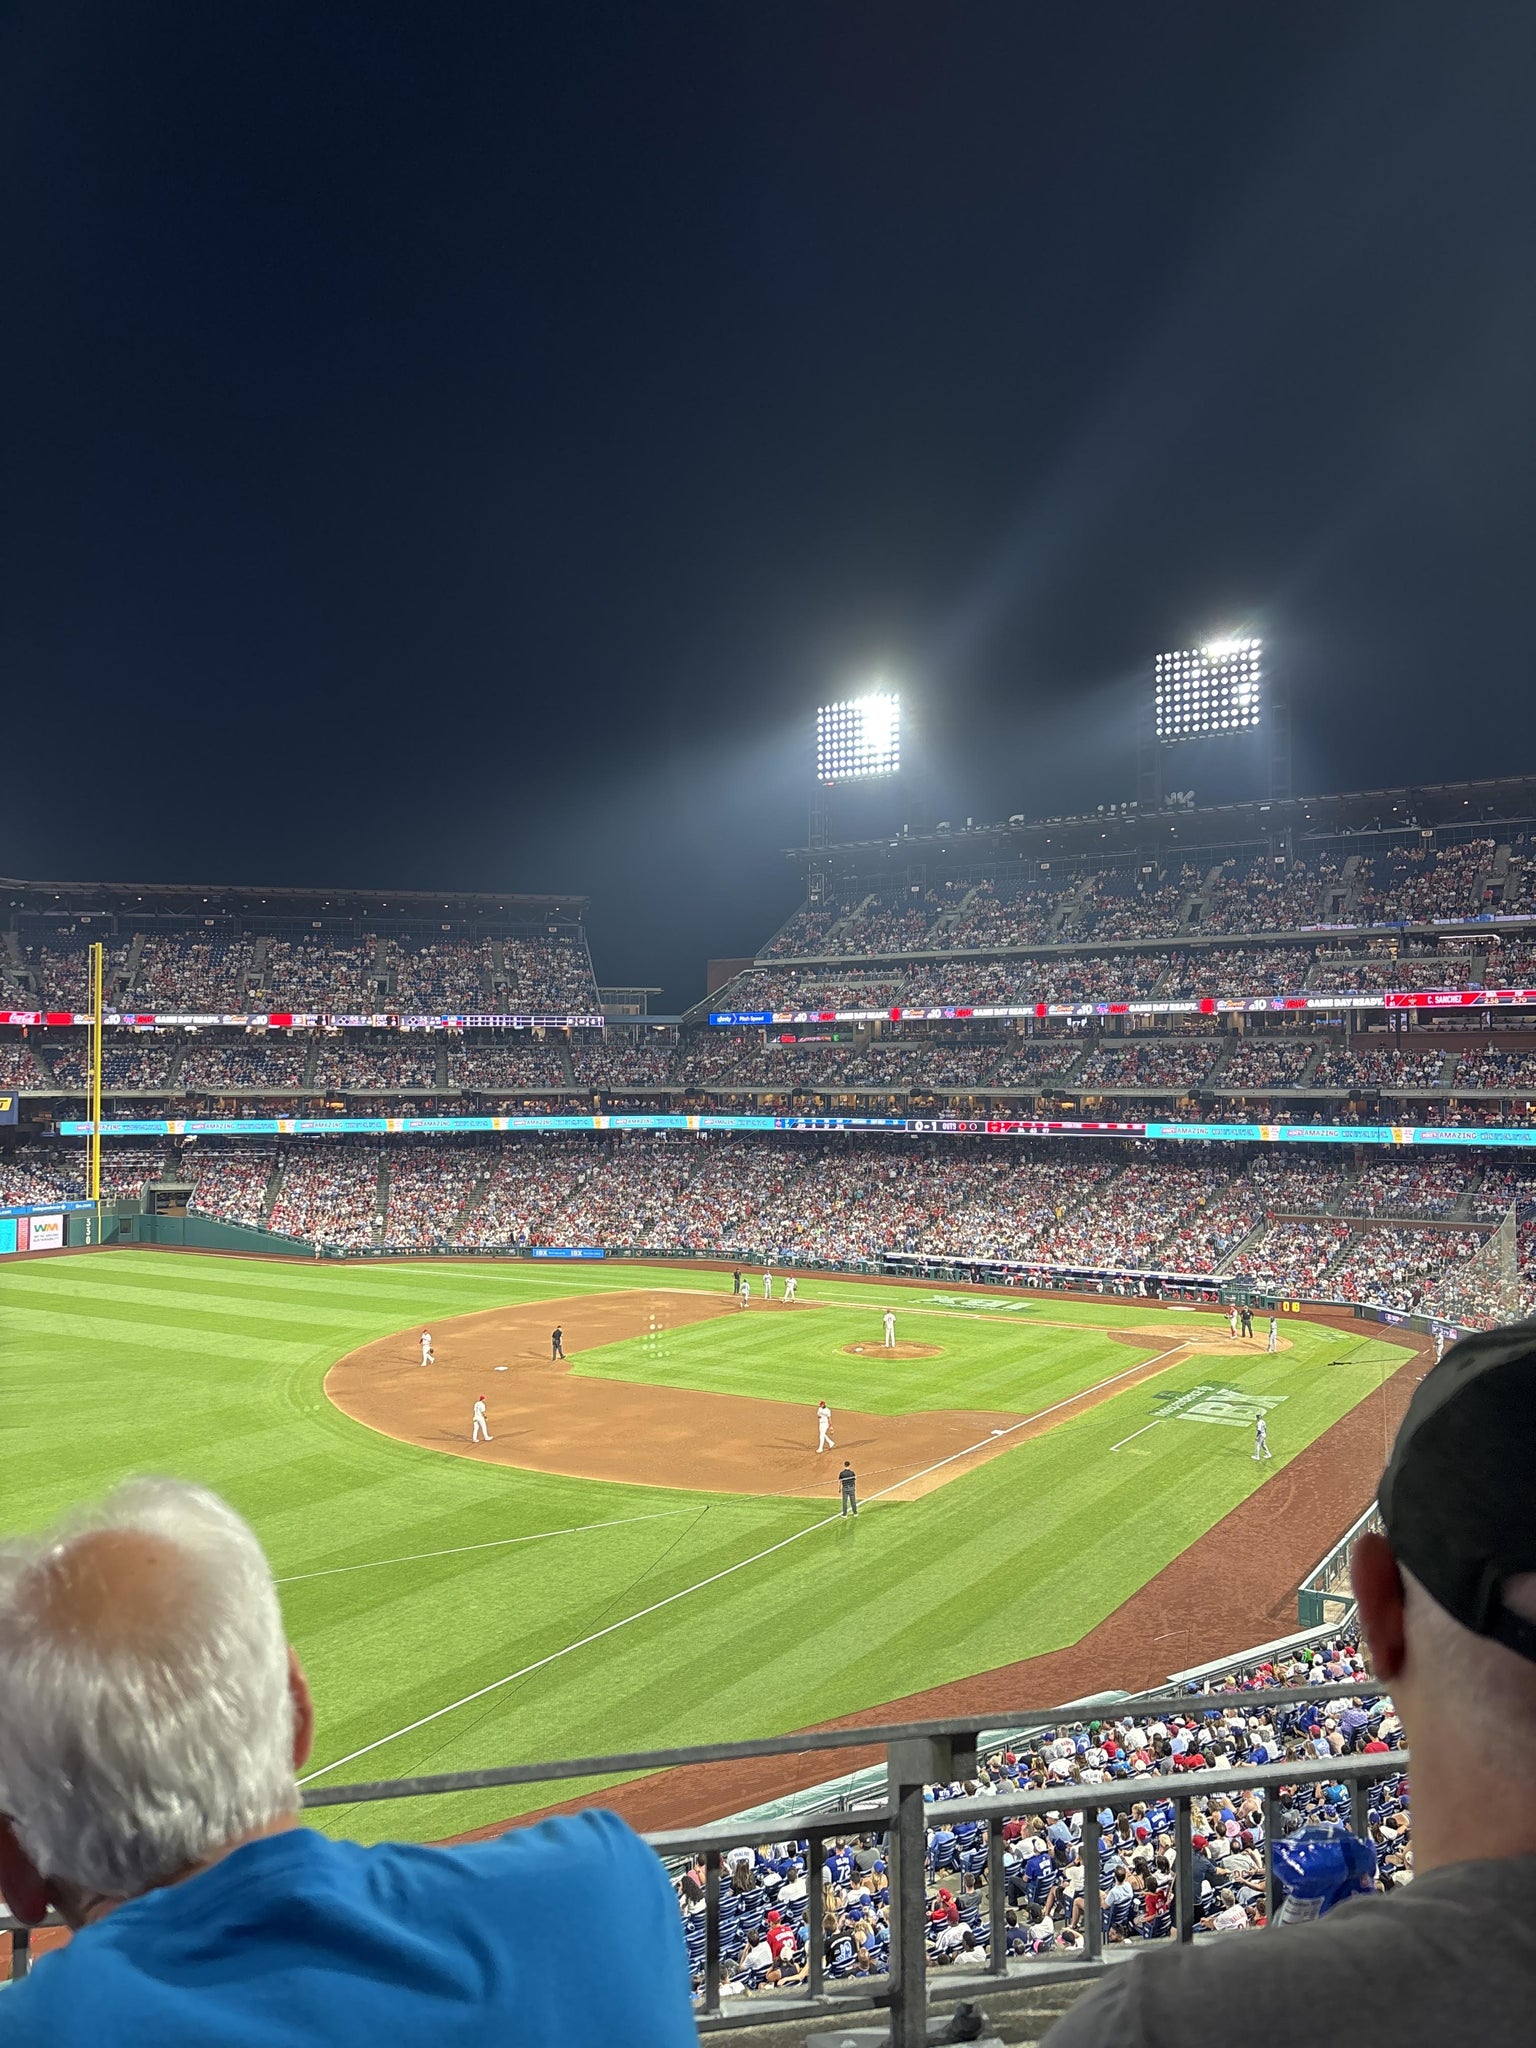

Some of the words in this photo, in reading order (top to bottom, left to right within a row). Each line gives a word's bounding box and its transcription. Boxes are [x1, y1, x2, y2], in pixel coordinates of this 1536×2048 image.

[1435, 994, 1463, 1004] SANCHEZ
[942, 1122, 956, 1131] OUTS
[1177, 1127, 1209, 1135] AMAZING
[1304, 1128, 1339, 1137] AMAZING
[1440, 1131, 1477, 1140] AMAZING
[34, 1222, 58, 1232] WM
